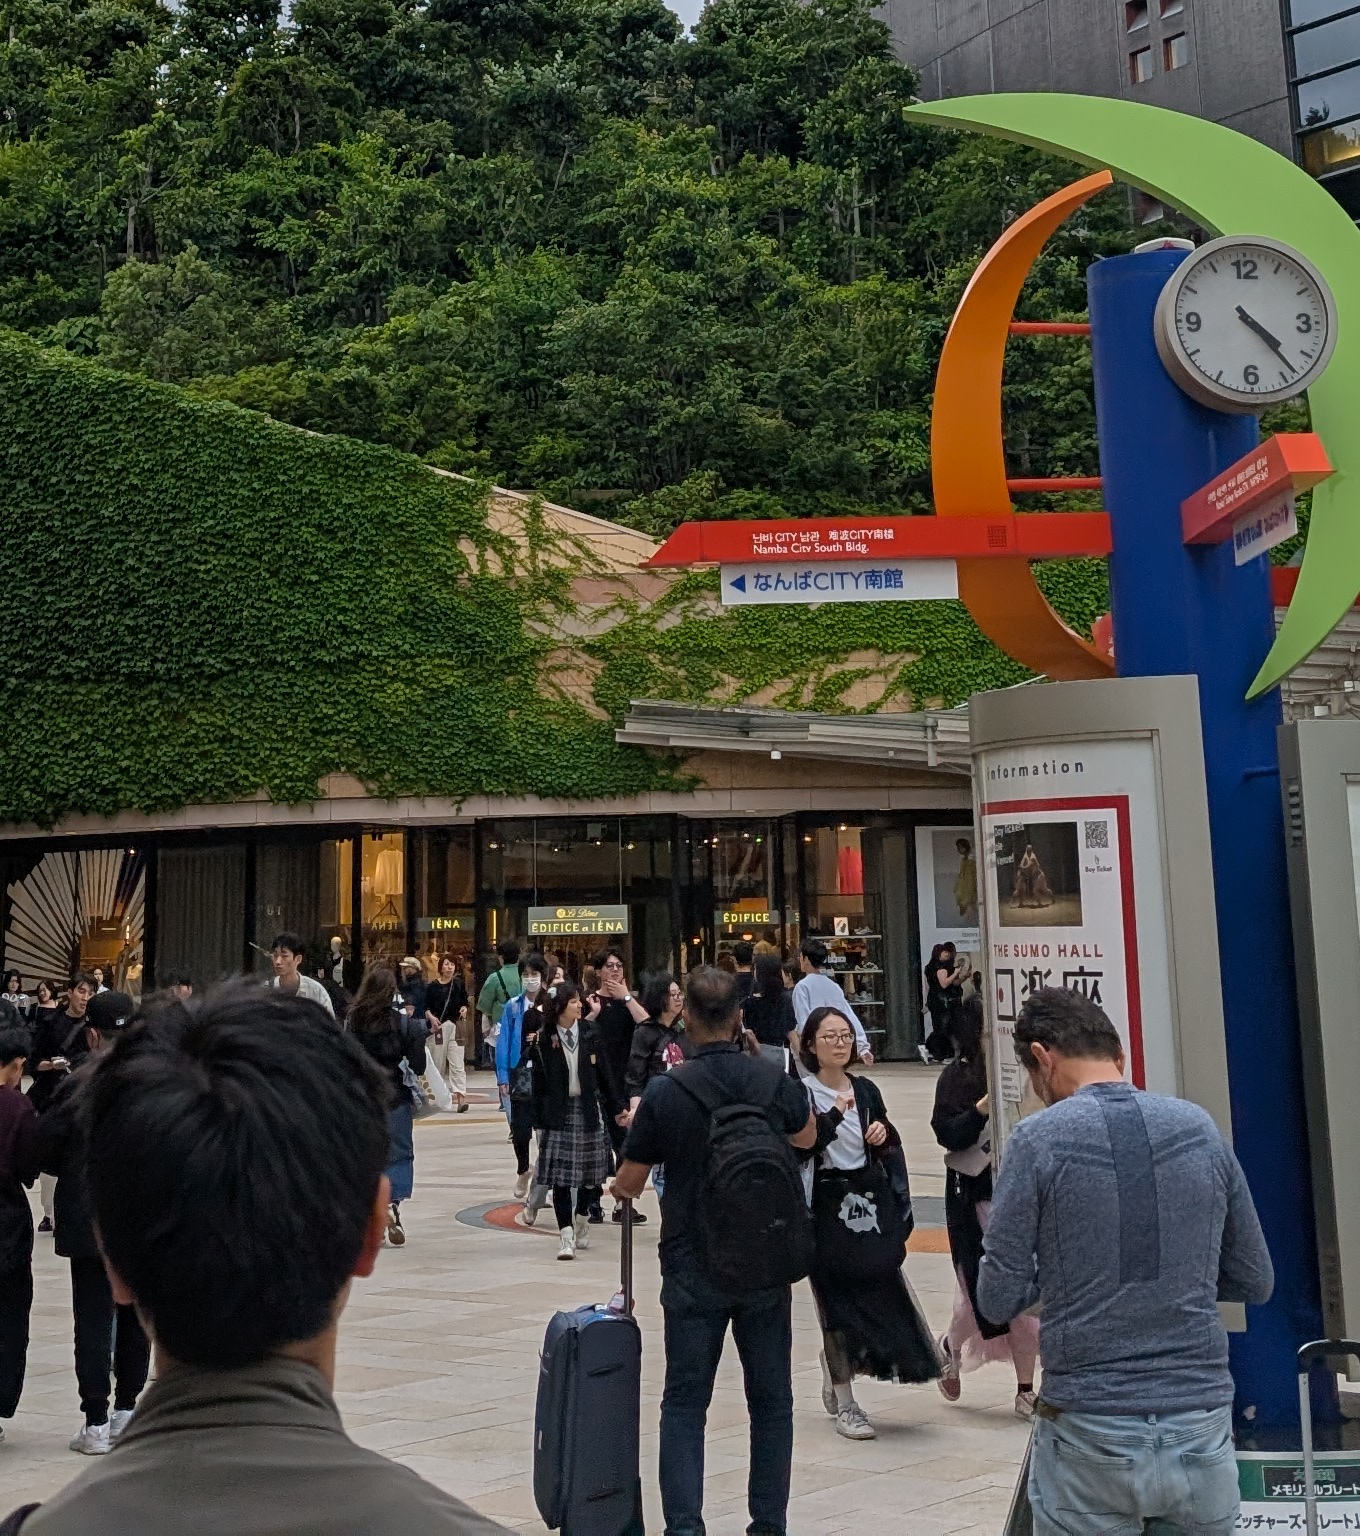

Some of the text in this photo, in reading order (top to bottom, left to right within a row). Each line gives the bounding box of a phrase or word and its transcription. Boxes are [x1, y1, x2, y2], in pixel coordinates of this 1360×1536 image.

[1231, 260, 1259, 279] 12
[1185, 312, 1202, 332] 9
[1296, 313, 1312, 333] 3
[1243, 365, 1259, 385] 6
[775, 532, 797, 542] CITY
[753, 541, 870, 554] Namba City South Bldg.
[753, 568, 904, 591] なんばCITY南館
[987, 760, 1084, 781] information
[994, 944, 1104, 958] THE SUMO HALL
